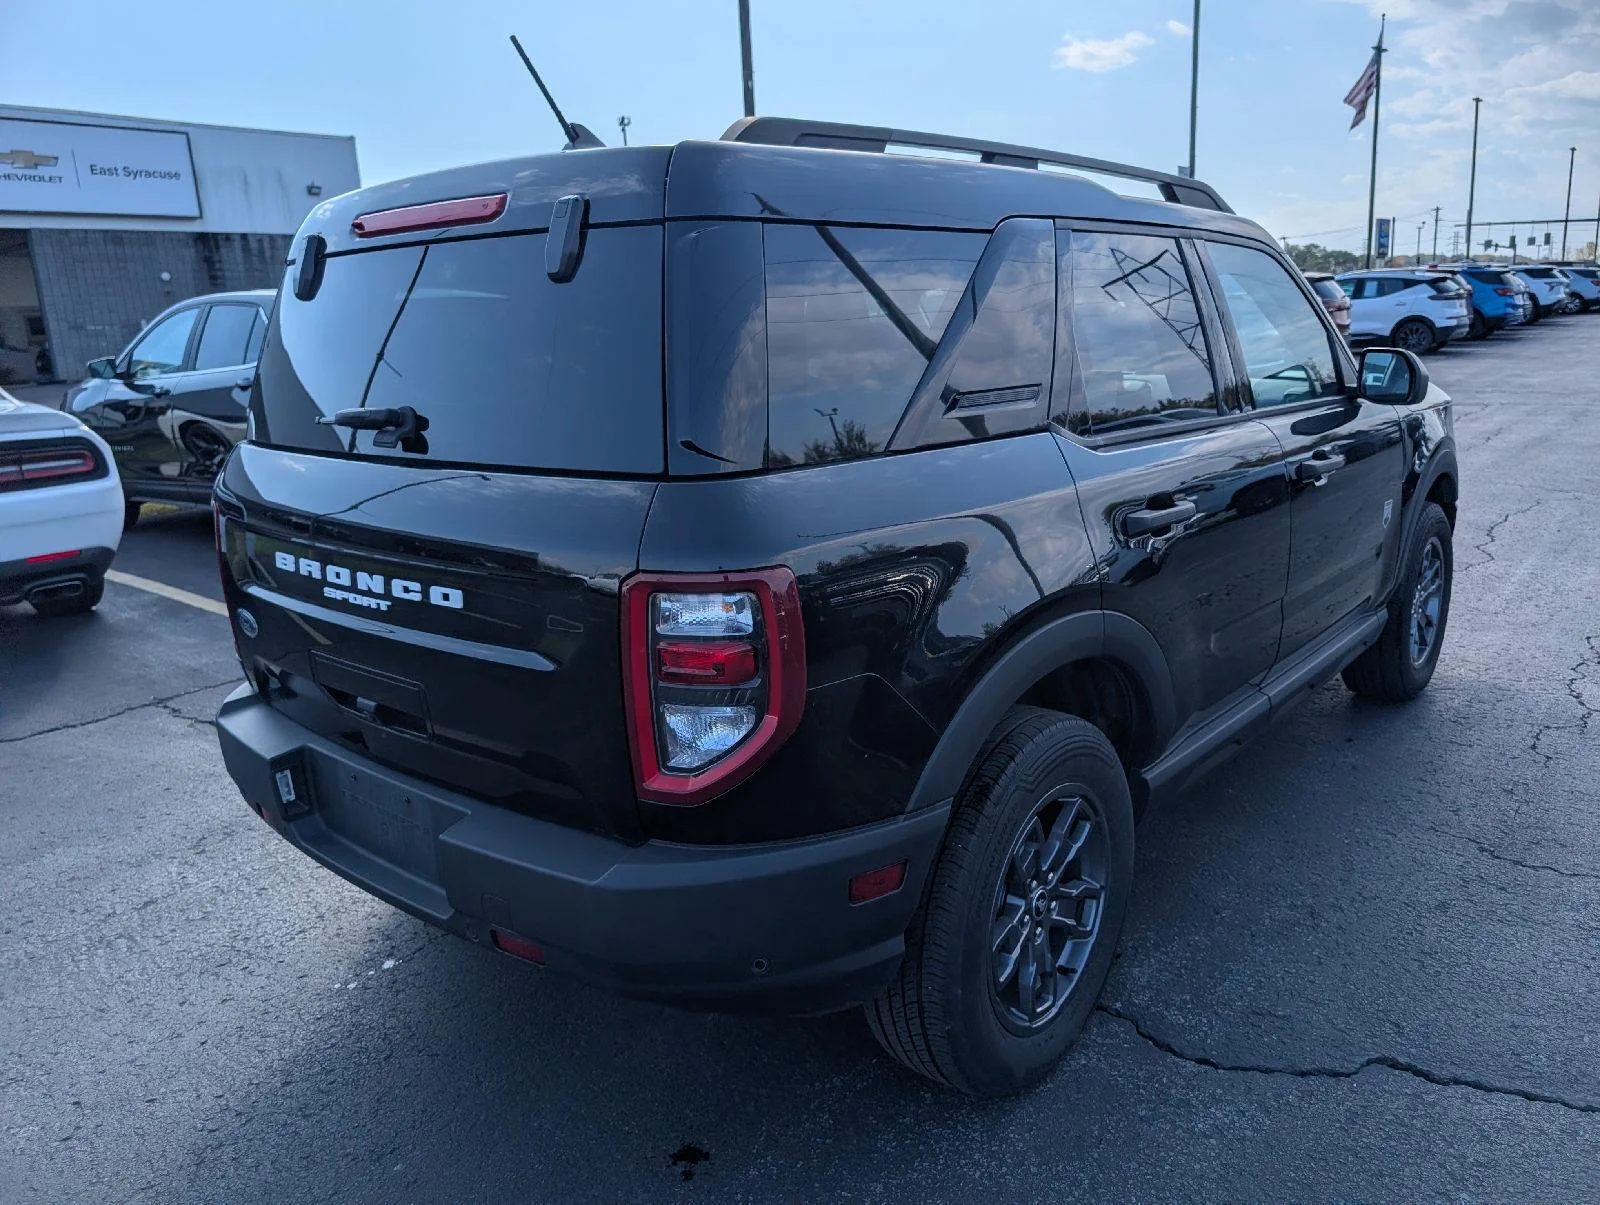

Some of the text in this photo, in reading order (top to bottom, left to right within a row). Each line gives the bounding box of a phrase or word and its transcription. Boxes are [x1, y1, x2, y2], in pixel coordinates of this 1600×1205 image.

[90, 164, 181, 181] East Syracuse
[275, 551, 464, 609] BRONCO
[323, 586, 392, 611] SPORT
